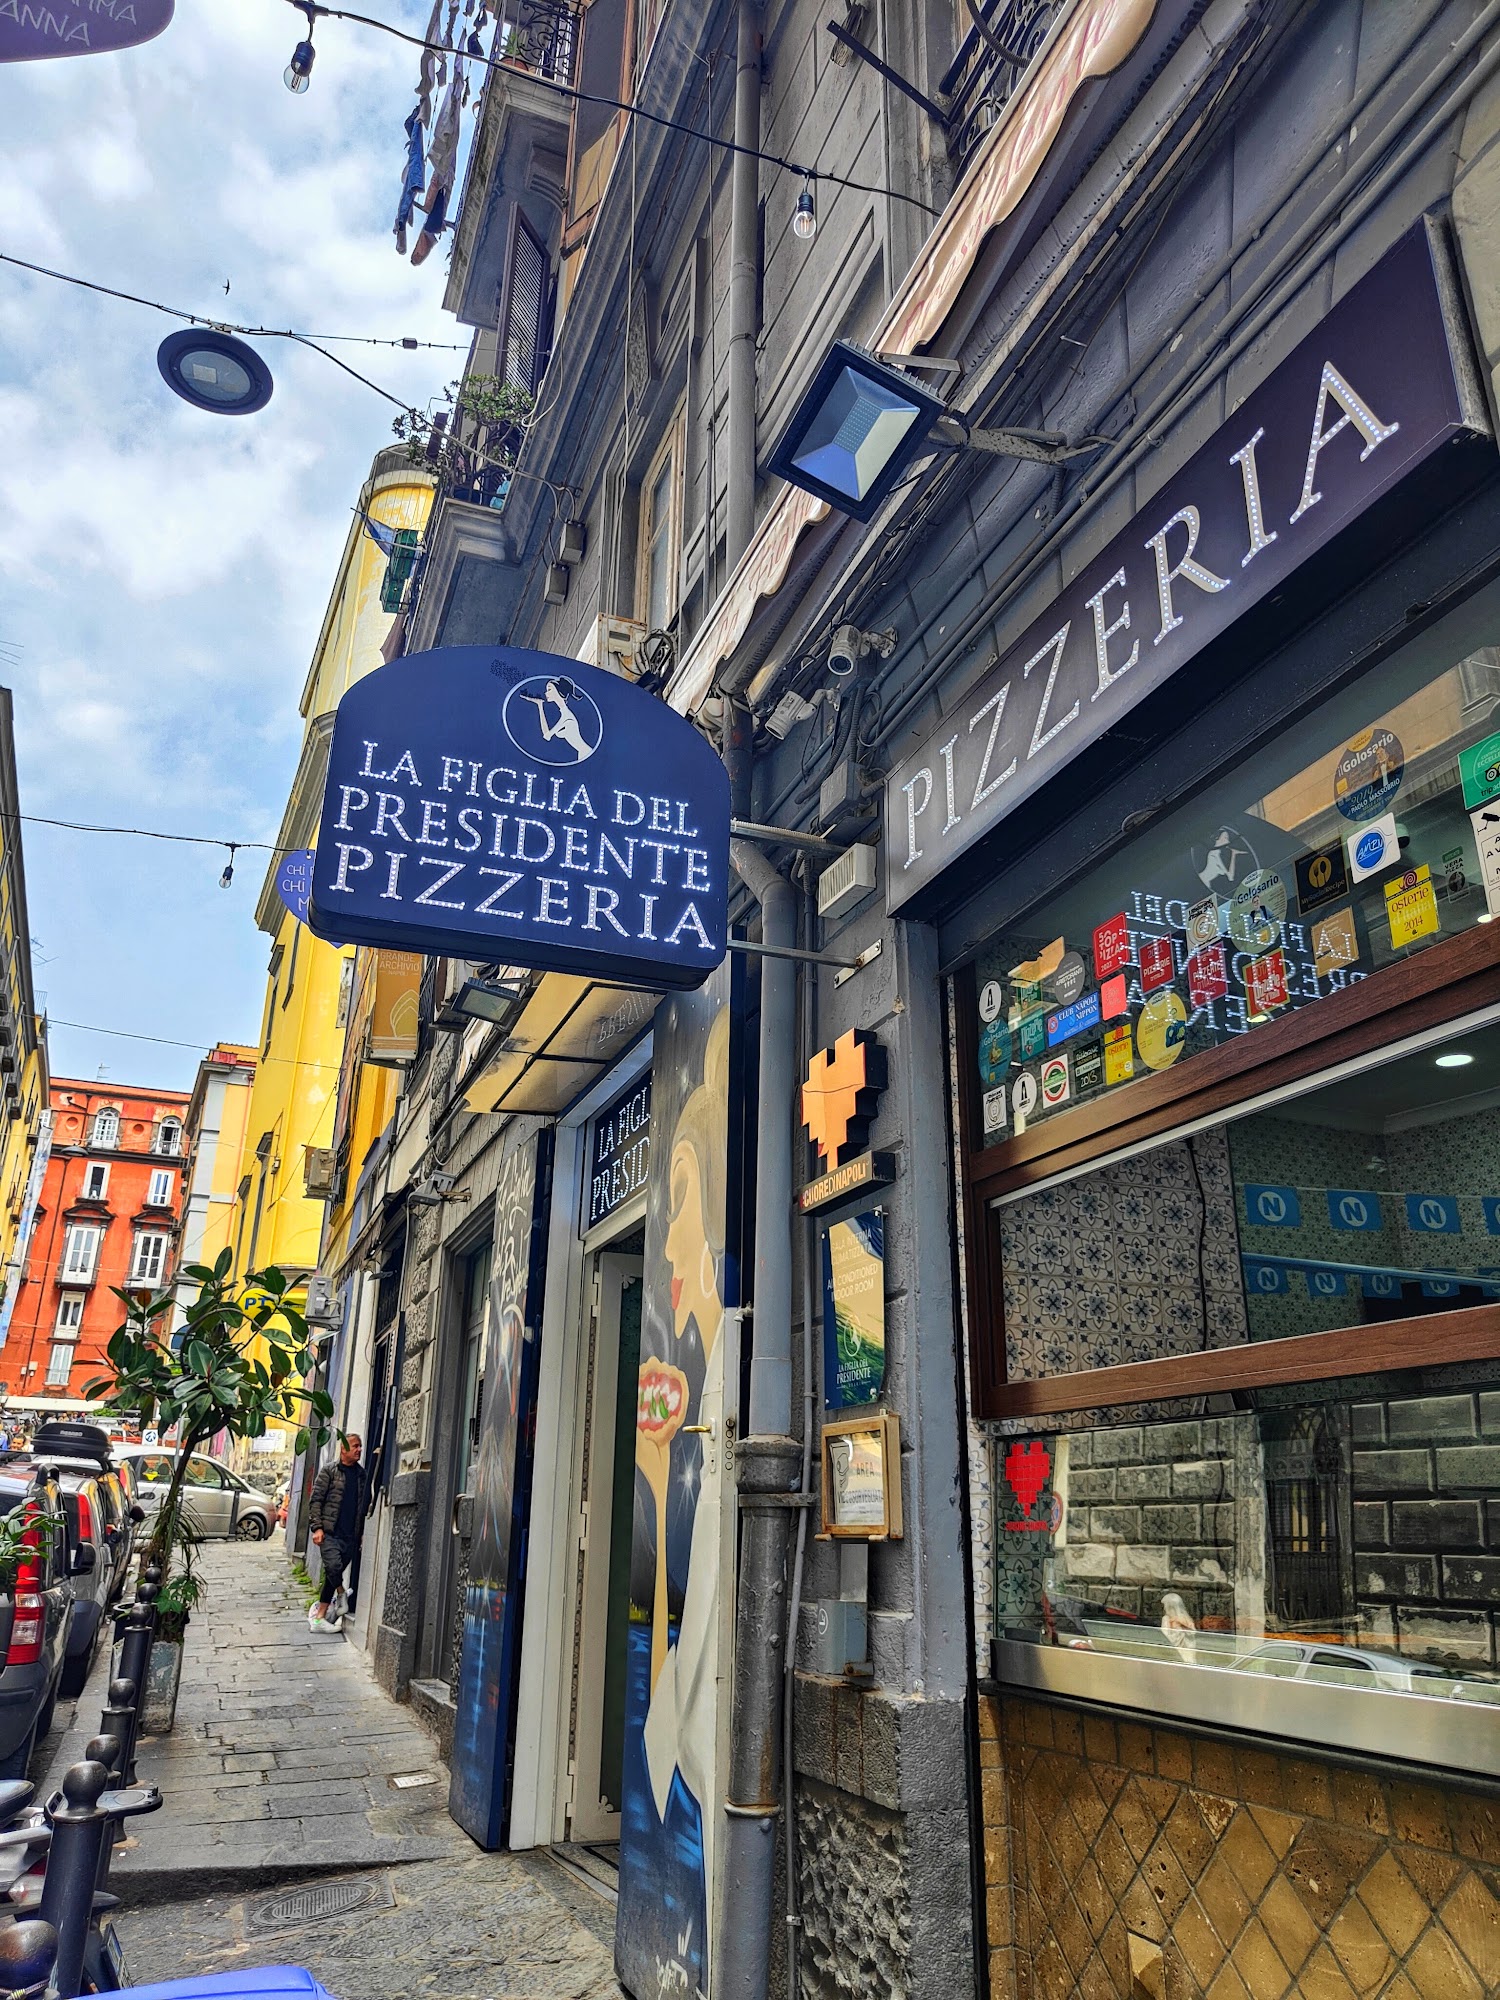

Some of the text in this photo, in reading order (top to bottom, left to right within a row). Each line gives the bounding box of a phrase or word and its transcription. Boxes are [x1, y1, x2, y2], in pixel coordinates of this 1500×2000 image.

[902, 359, 1400, 871] PIZZERIA
[358, 740, 698, 838] LA FIGLIA DEL
[1351, 799, 1369, 813] PAOLO
[1368, 777, 1401, 802] MASSOBRIO
[334, 783, 711, 898] PRESIDENTE
[1444, 857, 1463, 869] VERA
[329, 842, 717, 951] PIZZERIA
[1391, 887, 1428, 914] osterie
[1404, 915, 1424, 931] 2014
[1099, 932, 1117, 950] TOP
[380, 951, 415, 963] GRANDE
[1099, 943, 1123, 960] PIZZA
[379, 960, 420, 973] ARCHIVIO
[1058, 1007, 1074, 1021] CLUB
[1075, 995, 1097, 1011] NAPOLI
[1075, 1004, 1097, 1021] NIPPON
[836, 1366, 871, 1385] PRESIDENTE
